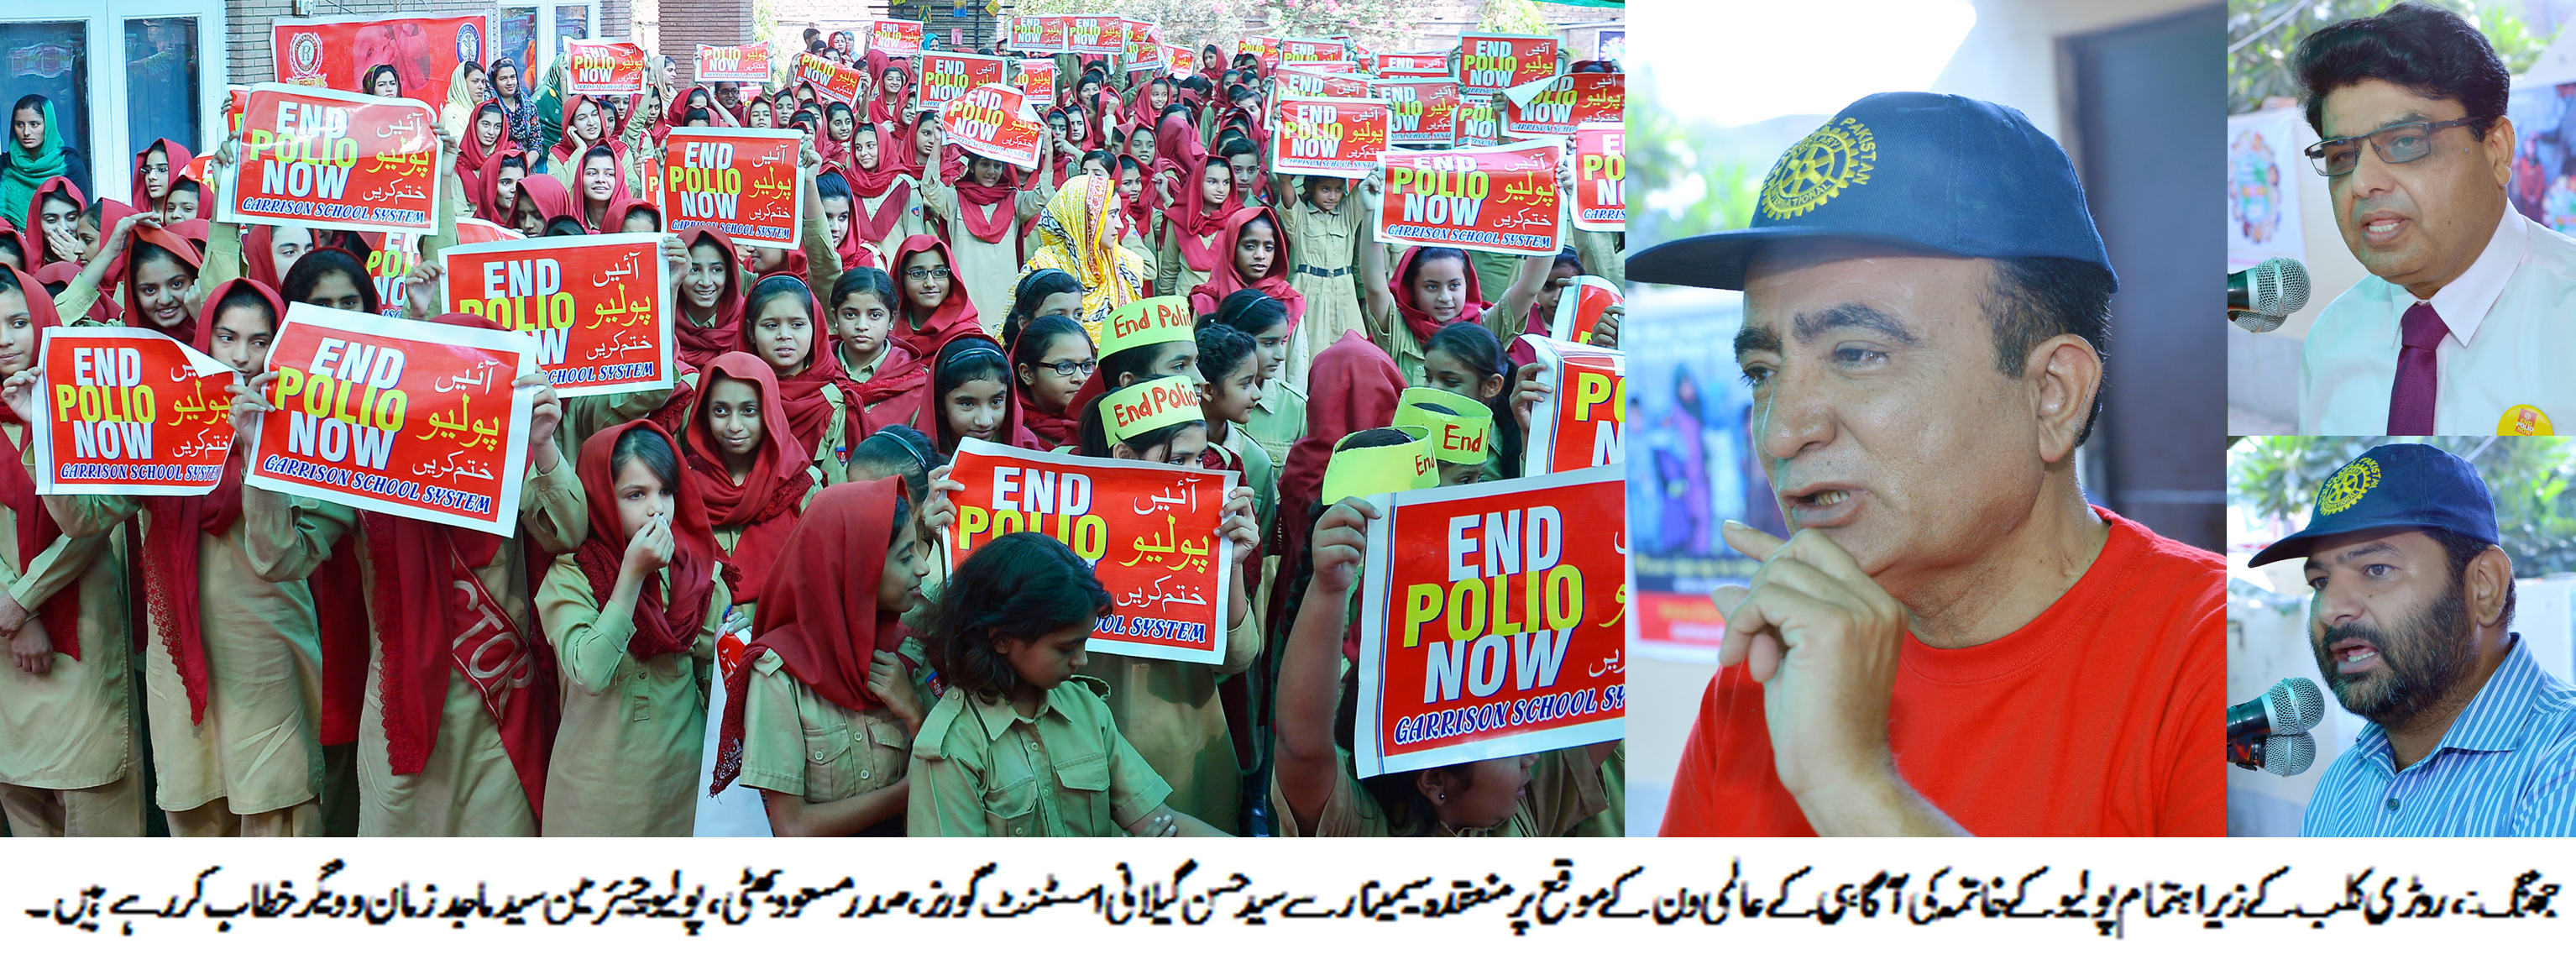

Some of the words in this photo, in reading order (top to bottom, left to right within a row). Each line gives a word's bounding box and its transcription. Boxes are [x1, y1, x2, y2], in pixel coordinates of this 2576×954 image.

[882, 24, 899, 32] END
[1014, 25, 1043, 34] POLIO
[1069, 27, 1101, 36] POLIO
[1076, 18, 1097, 28] END
[876, 31, 902, 39] POLIO
[877, 38, 899, 48] NOW
[1018, 33, 1041, 42] NOW
[1074, 34, 1099, 45] NOW
[1245, 37, 1264, 45] END
[581, 47, 609, 57] END
[704, 48, 741, 60] POLIO
[1239, 44, 1265, 53] POLIO
[1291, 45, 1316, 55] END
[1476, 40, 1512, 57] END
[1526, 43, 1550, 56] آئیں
[573, 55, 615, 70] POLIO
[619, 56, 643, 71] پولیو
[709, 59, 740, 71] NOW
[801, 54, 835, 78] POLIO
[935, 60, 965, 75] END
[1388, 57, 1415, 69] END
[1463, 55, 1517, 72] POLIO
[1521, 56, 1553, 74] پولیو
[579, 68, 613, 82] NOW
[804, 66, 832, 86] NOW
[835, 71, 857, 87] پولیو
[925, 72, 969, 87] POLIO
[1289, 74, 1325, 94] END
[1470, 70, 1513, 87] NOW
[966, 90, 1002, 111] END
[1381, 86, 1416, 102] END
[1582, 88, 1620, 109] پولیو
[276, 101, 348, 139] END
[950, 101, 1004, 127] POLIO
[1296, 106, 1338, 124] END
[1353, 107, 1379, 122] آئیں
[1521, 103, 1573, 123] NOW
[377, 113, 423, 137] آئیں
[953, 117, 998, 142] NOW
[1284, 122, 1343, 141] POLIO
[1348, 122, 1383, 143] پولیو
[250, 129, 358, 168] POLIO
[684, 142, 734, 169] END
[752, 144, 788, 167] آئیں
[1291, 139, 1341, 158] NOW
[1840, 117, 1877, 185] PAKISTAN
[1413, 156, 1477, 171] END
[1505, 153, 1545, 171] آئیں
[262, 160, 352, 199] NOW
[363, 178, 403, 201] کریں
[670, 166, 741, 195] POLIO
[749, 166, 792, 201] پولیو
[1392, 167, 1489, 200] POLIO
[1496, 170, 1555, 207] پولیو
[395, 185, 426, 205] ختم
[681, 191, 738, 219] NOW
[243, 197, 314, 216] GARRISON
[315, 206, 369, 220] SCHOOL
[373, 209, 425, 224] SYSTEM
[1404, 193, 1484, 226] NOW
[720, 223, 754, 236] SCHOOL
[756, 226, 790, 239] SYSTEM
[1387, 224, 1450, 241] GARRISON
[1451, 229, 1500, 245] SCHOOL
[1502, 233, 1552, 248] SYSTEM
[484, 259, 560, 299] END
[593, 251, 641, 287] آئیں
[586, 282, 652, 329] پولیو
[1113, 307, 1150, 338] End
[74, 348, 141, 386] END
[310, 338, 405, 389] END
[599, 361, 654, 380] SYSTEM
[435, 360, 499, 394] آئیں
[55, 385, 156, 424] POLIO
[275, 366, 407, 432] POLIO
[1113, 392, 1153, 427] End
[1152, 382, 1197, 414] Polio
[416, 393, 499, 451] پولیو
[2516, 422, 2533, 432] POLIO
[2517, 427, 2531, 435] NOW
[2521, 418, 2532, 427] END
[74, 421, 153, 459] NOW
[289, 411, 396, 470] NOW
[1443, 424, 1483, 453] End
[61, 463, 127, 479] GARRISON
[130, 465, 181, 480] SCHOOL
[412, 451, 463, 478] کریں
[454, 459, 493, 483] ختم
[264, 454, 352, 485] GARRISON
[352, 473, 418, 500] SCHOOL
[423, 486, 490, 514] SYSTEM
[992, 466, 1092, 516] END
[1134, 478, 1201, 514] آئیں
[1119, 514, 1208, 574] پولیو
[1448, 506, 1562, 582] END
[1404, 564, 1584, 647] POLIO
[1130, 616, 1206, 643] SYSTEM
[453, 580, 535, 720] CTOR
[1424, 626, 1572, 704] NOW
[1395, 701, 1510, 745] GARRISON
[1511, 688, 1596, 726] SCHOOL
